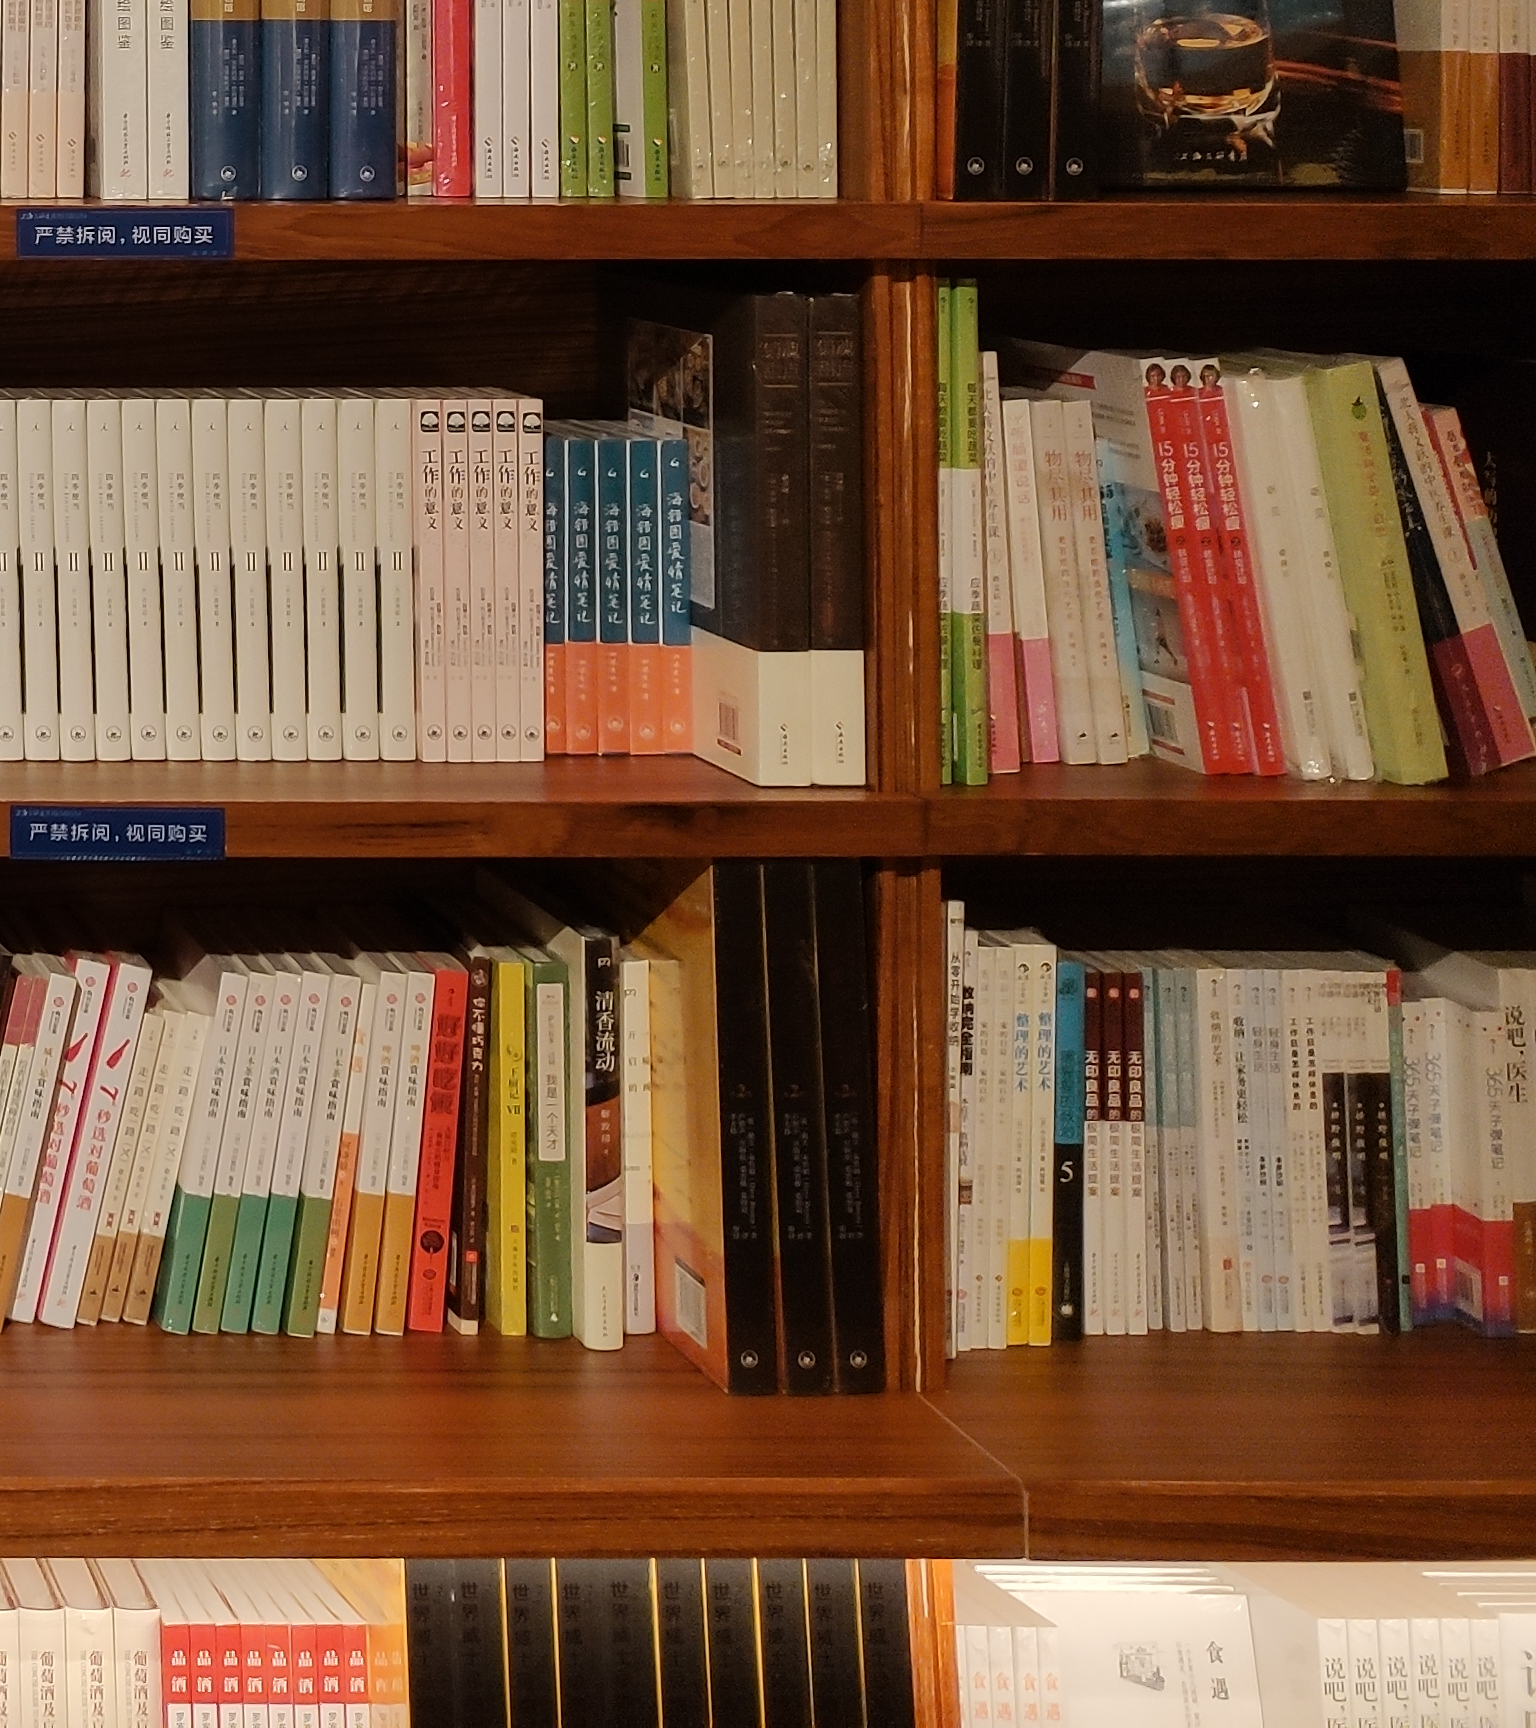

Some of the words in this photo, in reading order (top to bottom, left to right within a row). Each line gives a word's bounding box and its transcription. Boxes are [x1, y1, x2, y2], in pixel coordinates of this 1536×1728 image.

[33, 224, 215, 246] 严禁拆阅，视同购买
[422, 449, 440, 531] 工作的意义
[473, 449, 491, 531] 工作的意义
[1044, 450, 1068, 524] 物尽其用
[29, 823, 207, 843] 严禁拆阅，视同购买
[595, 990, 615, 1073] 清香流动
[1038, 1012, 1053, 1092] 整理的艺术
[1504, 1005, 1528, 1106] 说吧，医生
[545, 1074, 559, 1151] 我是一个天才
[171, 1650, 187, 1694] 品酒
[349, 1650, 365, 1694] 品酒
[1204, 1638, 1230, 1702] 食遇
